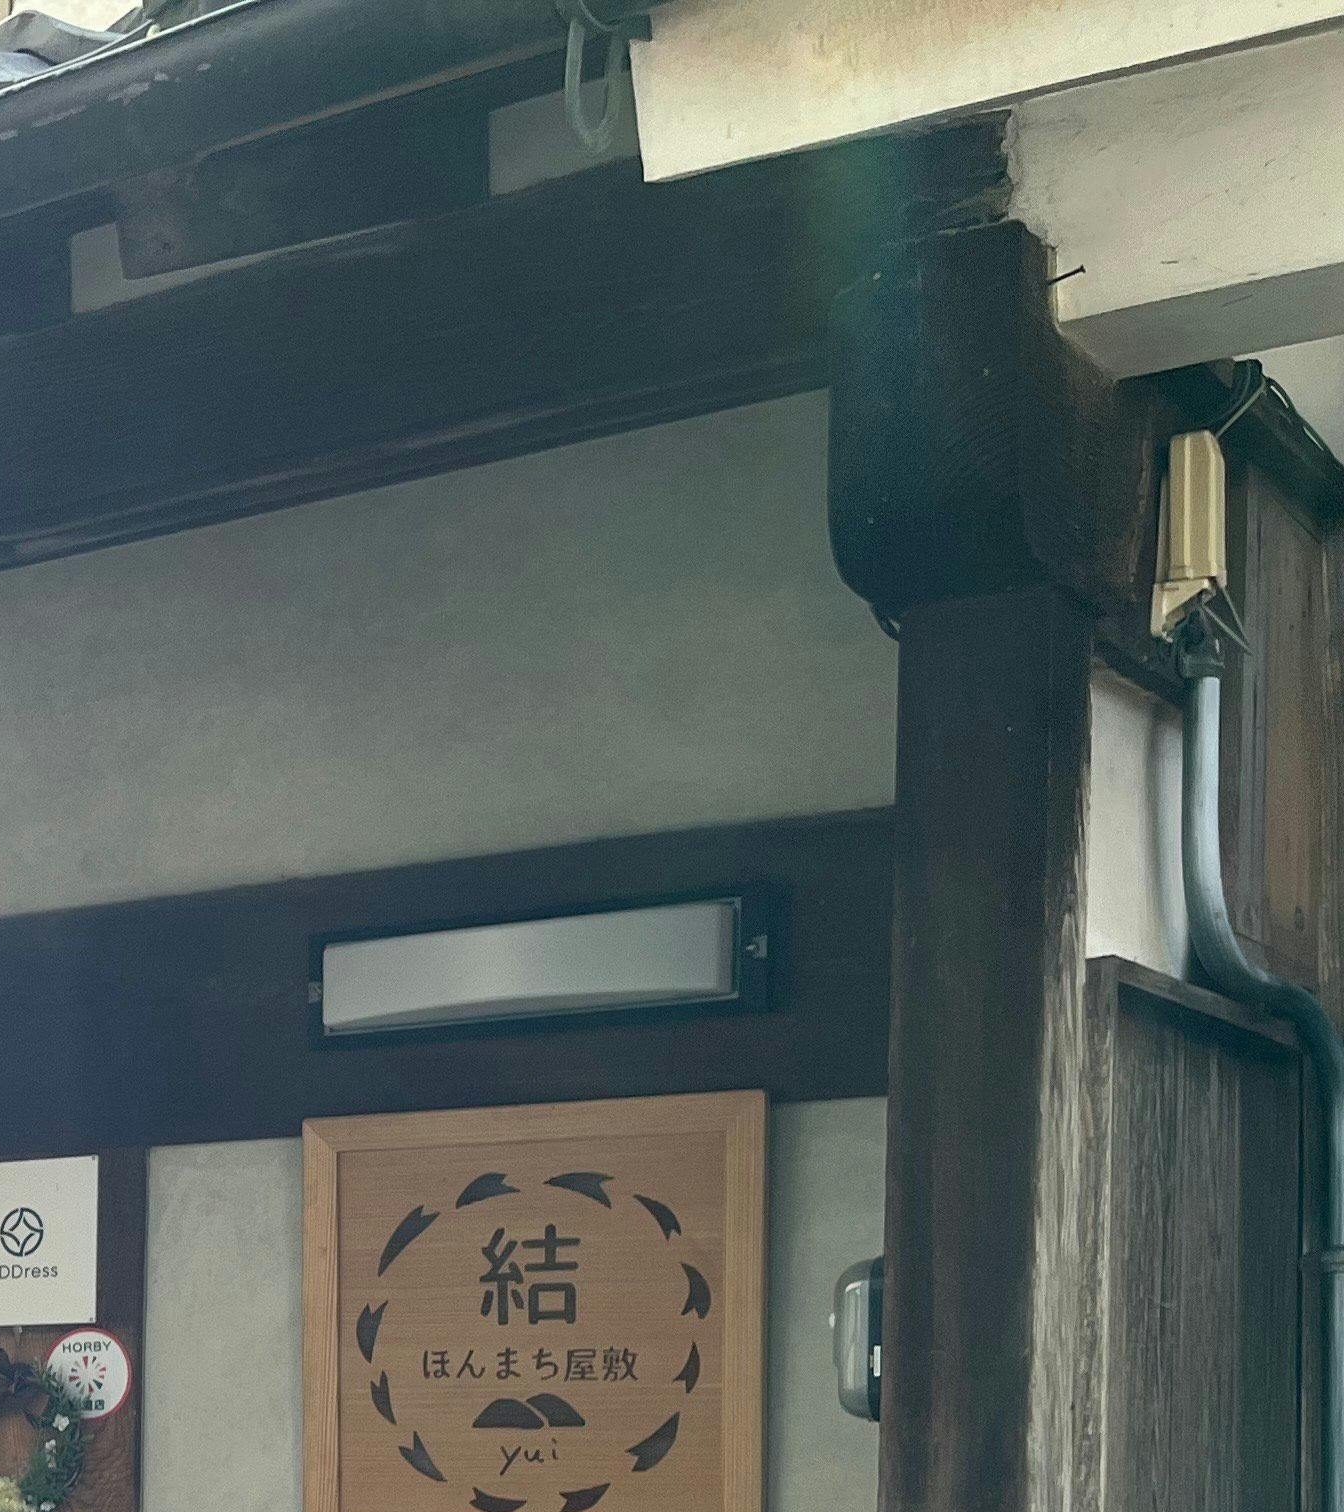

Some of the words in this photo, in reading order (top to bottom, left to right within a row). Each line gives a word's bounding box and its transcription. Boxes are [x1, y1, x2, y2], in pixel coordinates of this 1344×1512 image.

[480, 1224, 581, 1326] 結
[62, 1341, 112, 1353] HORBY
[422, 1347, 639, 1383] ほんまち屋敷
[499, 1438, 559, 1476] yui
